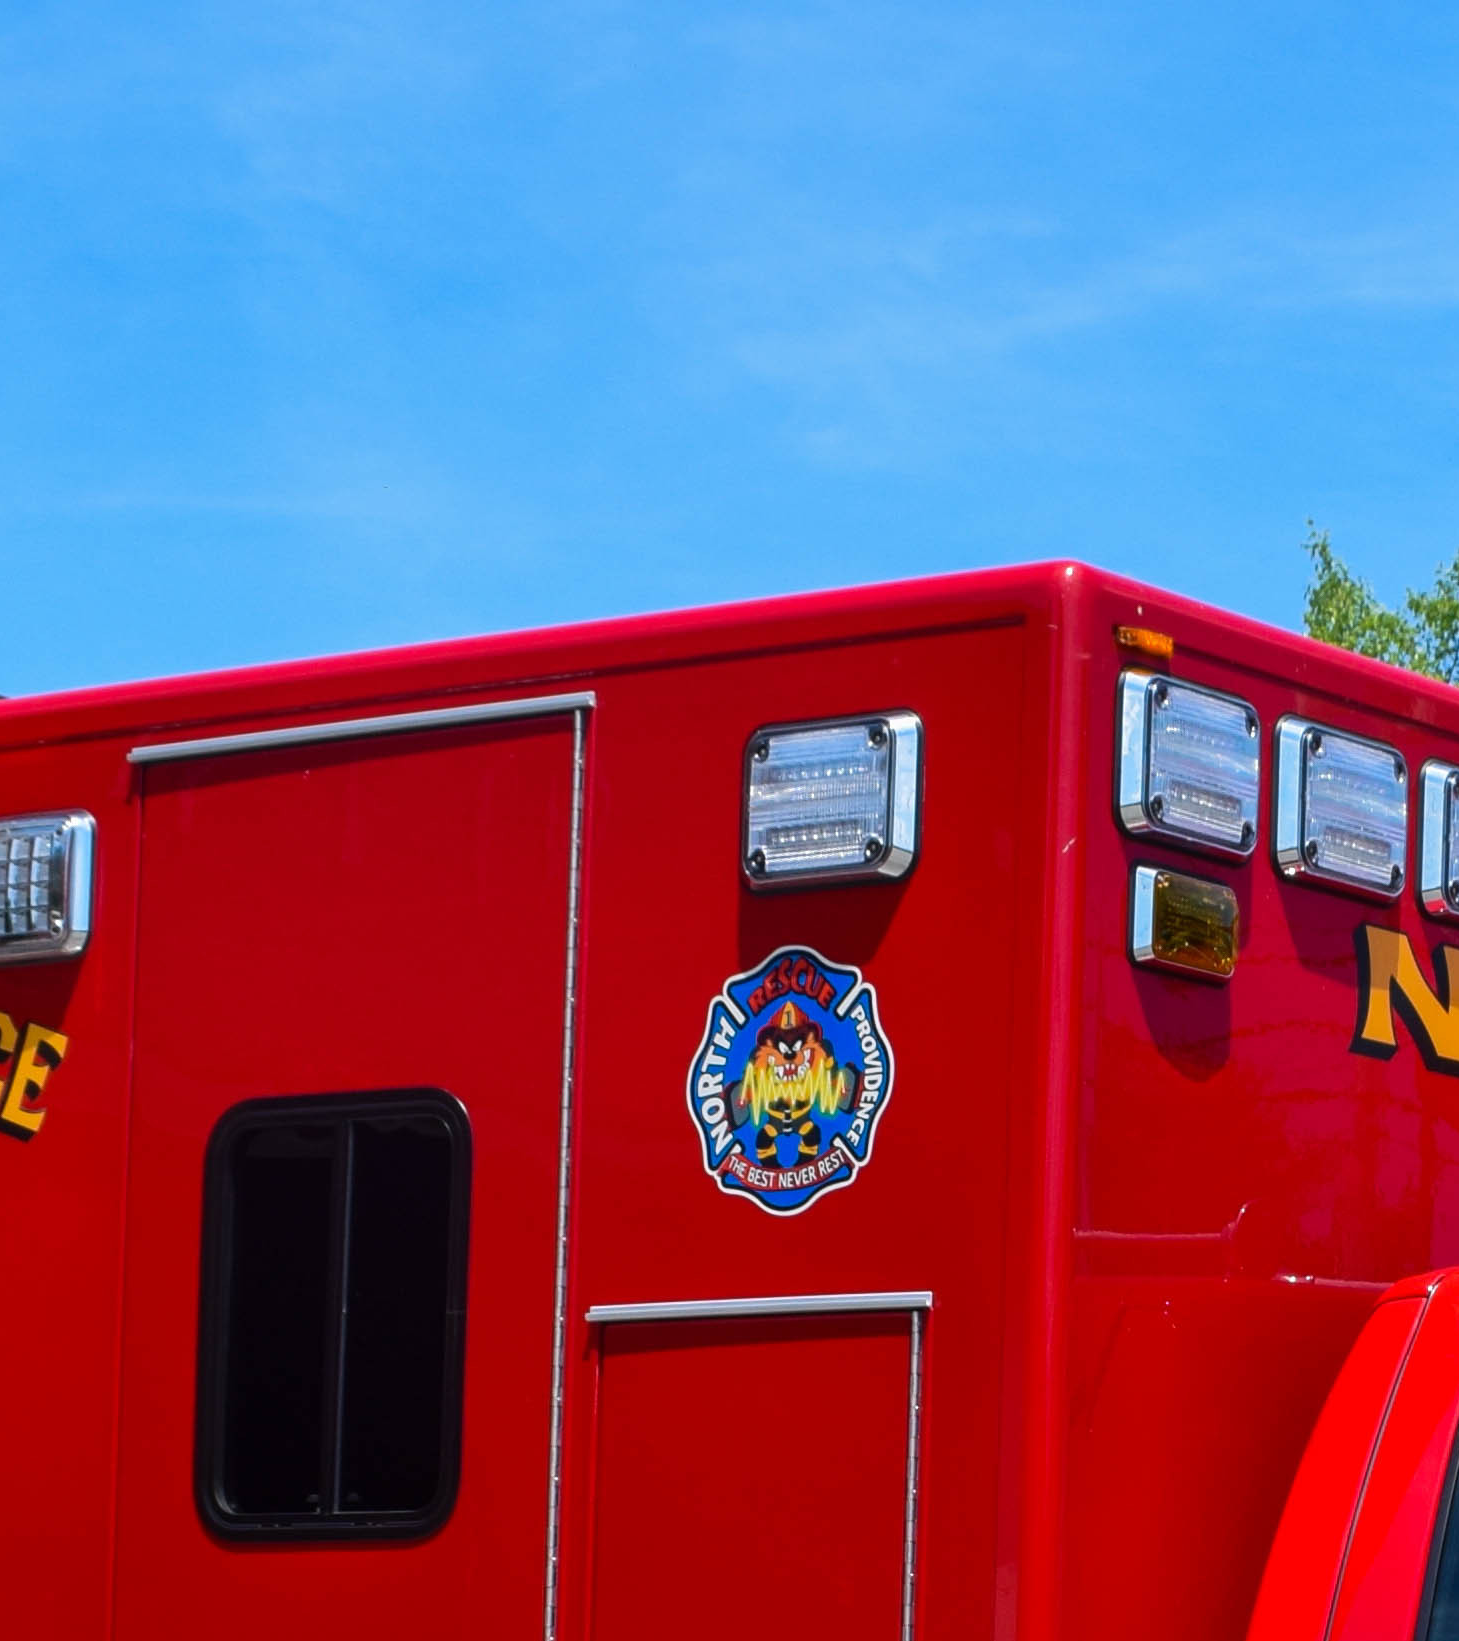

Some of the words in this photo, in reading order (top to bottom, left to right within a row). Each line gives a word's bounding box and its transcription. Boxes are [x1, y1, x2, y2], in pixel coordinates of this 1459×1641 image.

[747, 957, 837, 1014] RESCUE
[697, 1016, 736, 1155] NORTH
[847, 1004, 884, 1147] PROVIDENCE
[727, 1155, 747, 1180] THE
[747, 1166, 775, 1188] BEST
[777, 1167, 817, 1188] NEVER
[817, 1149, 845, 1177] REST
